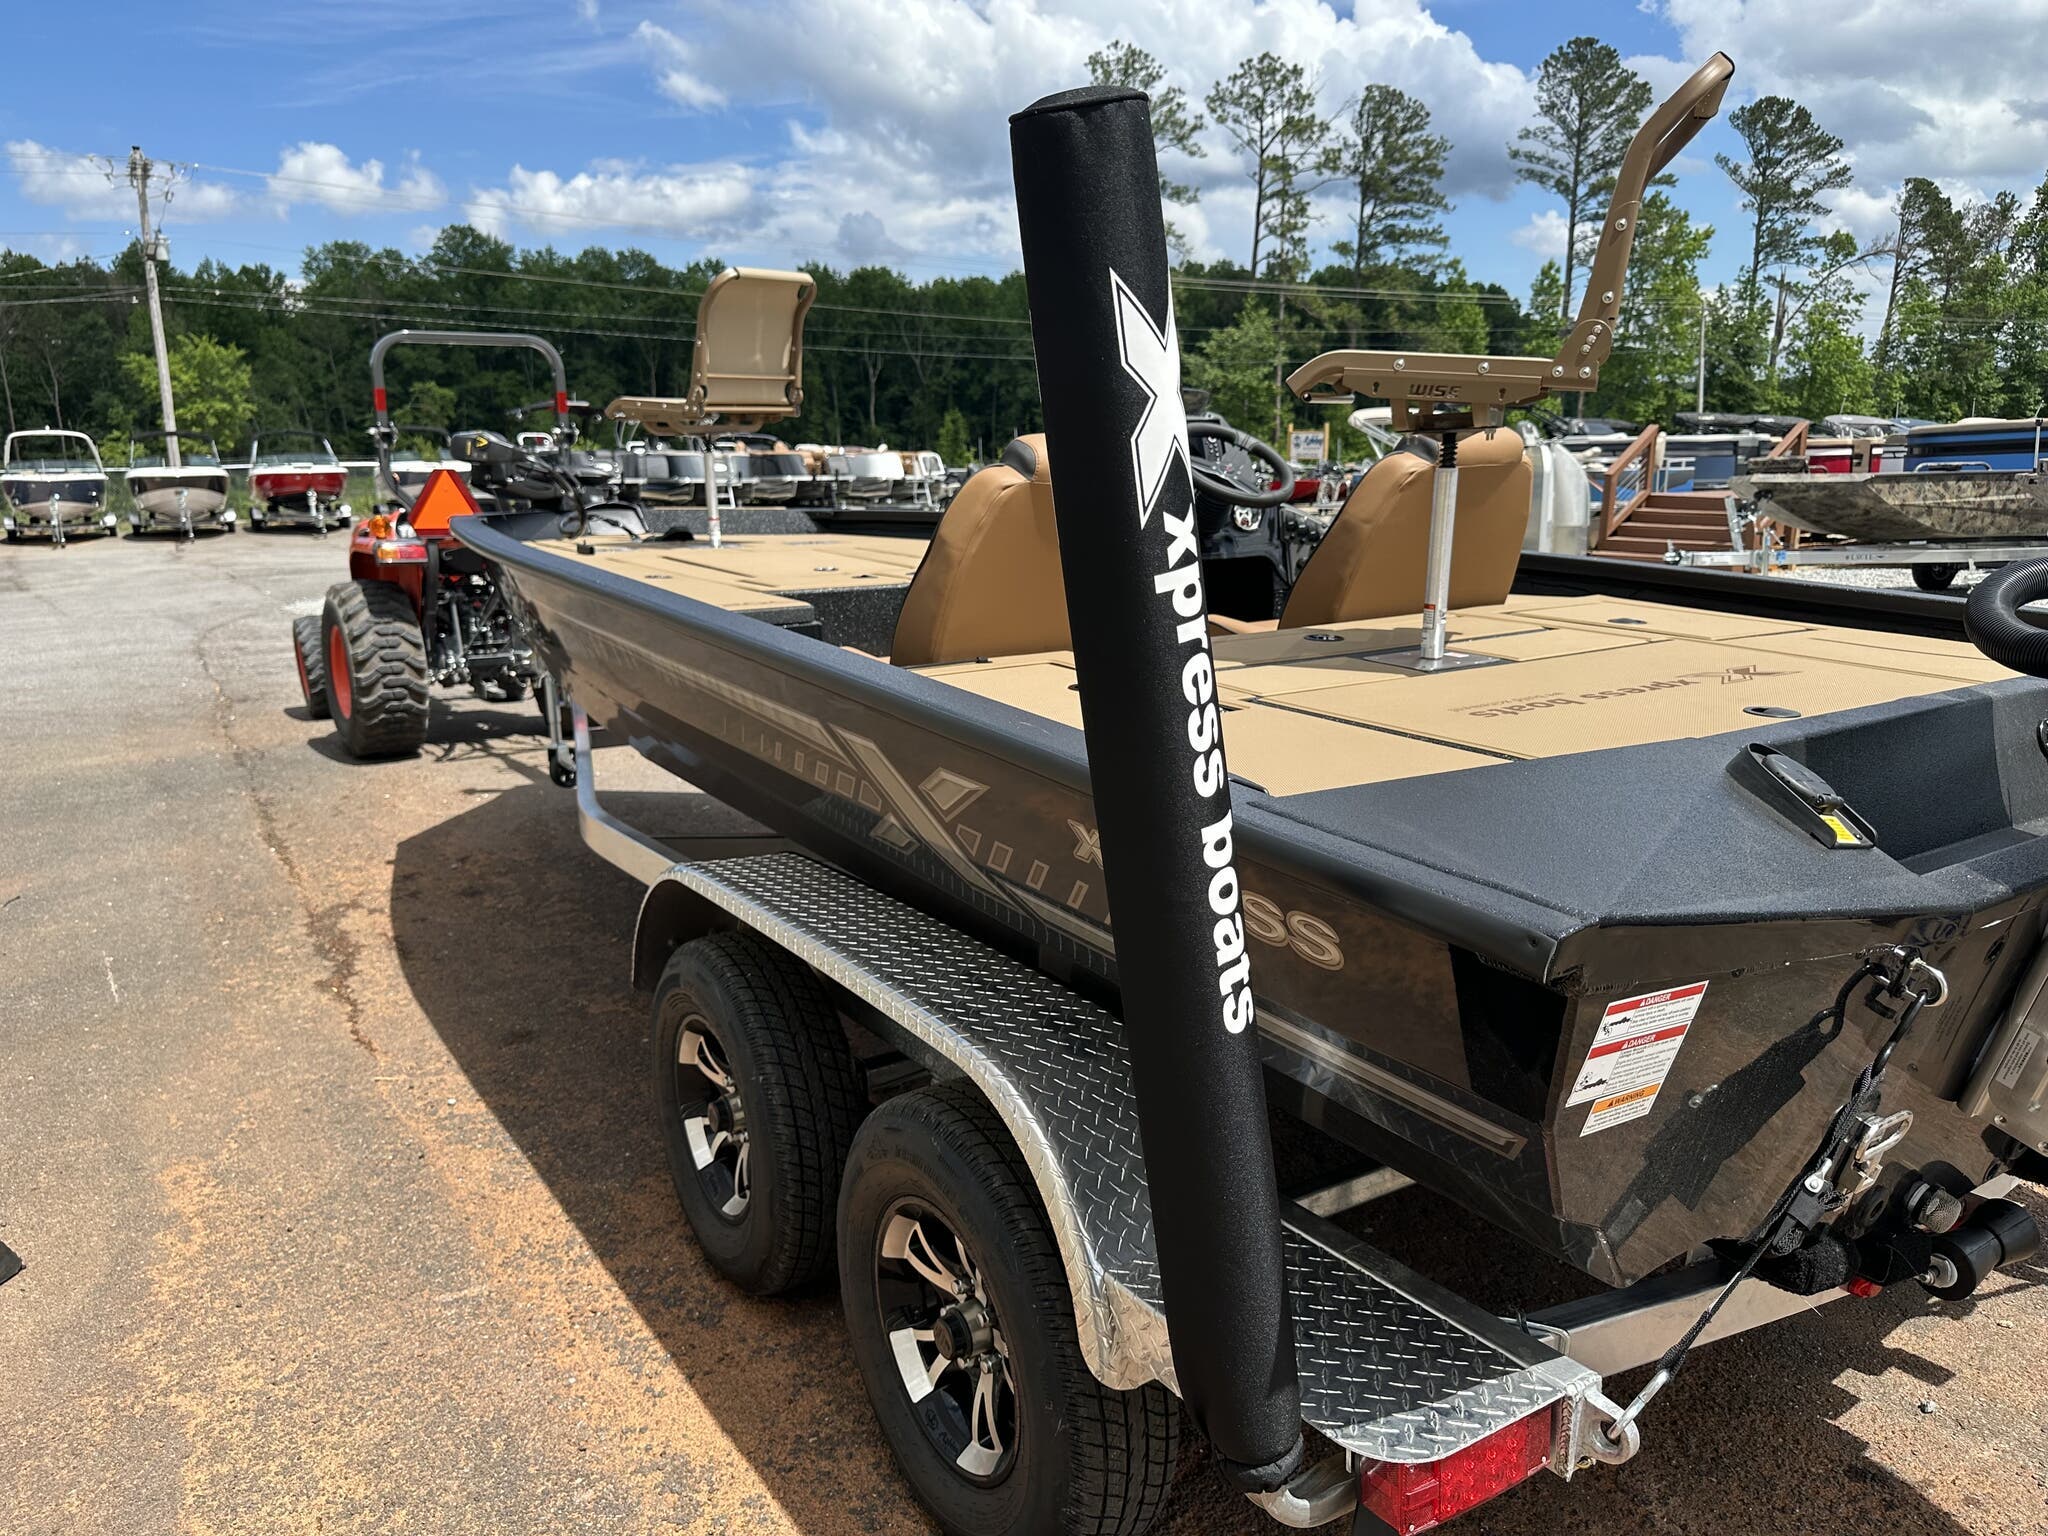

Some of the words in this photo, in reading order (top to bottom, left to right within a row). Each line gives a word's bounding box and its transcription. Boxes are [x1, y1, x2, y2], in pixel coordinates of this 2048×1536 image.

[1409, 384, 1462, 398] WISE
[1579, 678, 1701, 701] xpress
[1468, 697, 1586, 718] boats
[1154, 503, 1225, 798] xpress
[1201, 809, 1254, 1034] boats
[1645, 993, 1672, 1006] DANGER
[1627, 1034, 1656, 1048] DANGER
[1613, 1089, 1646, 1105] WARNING
